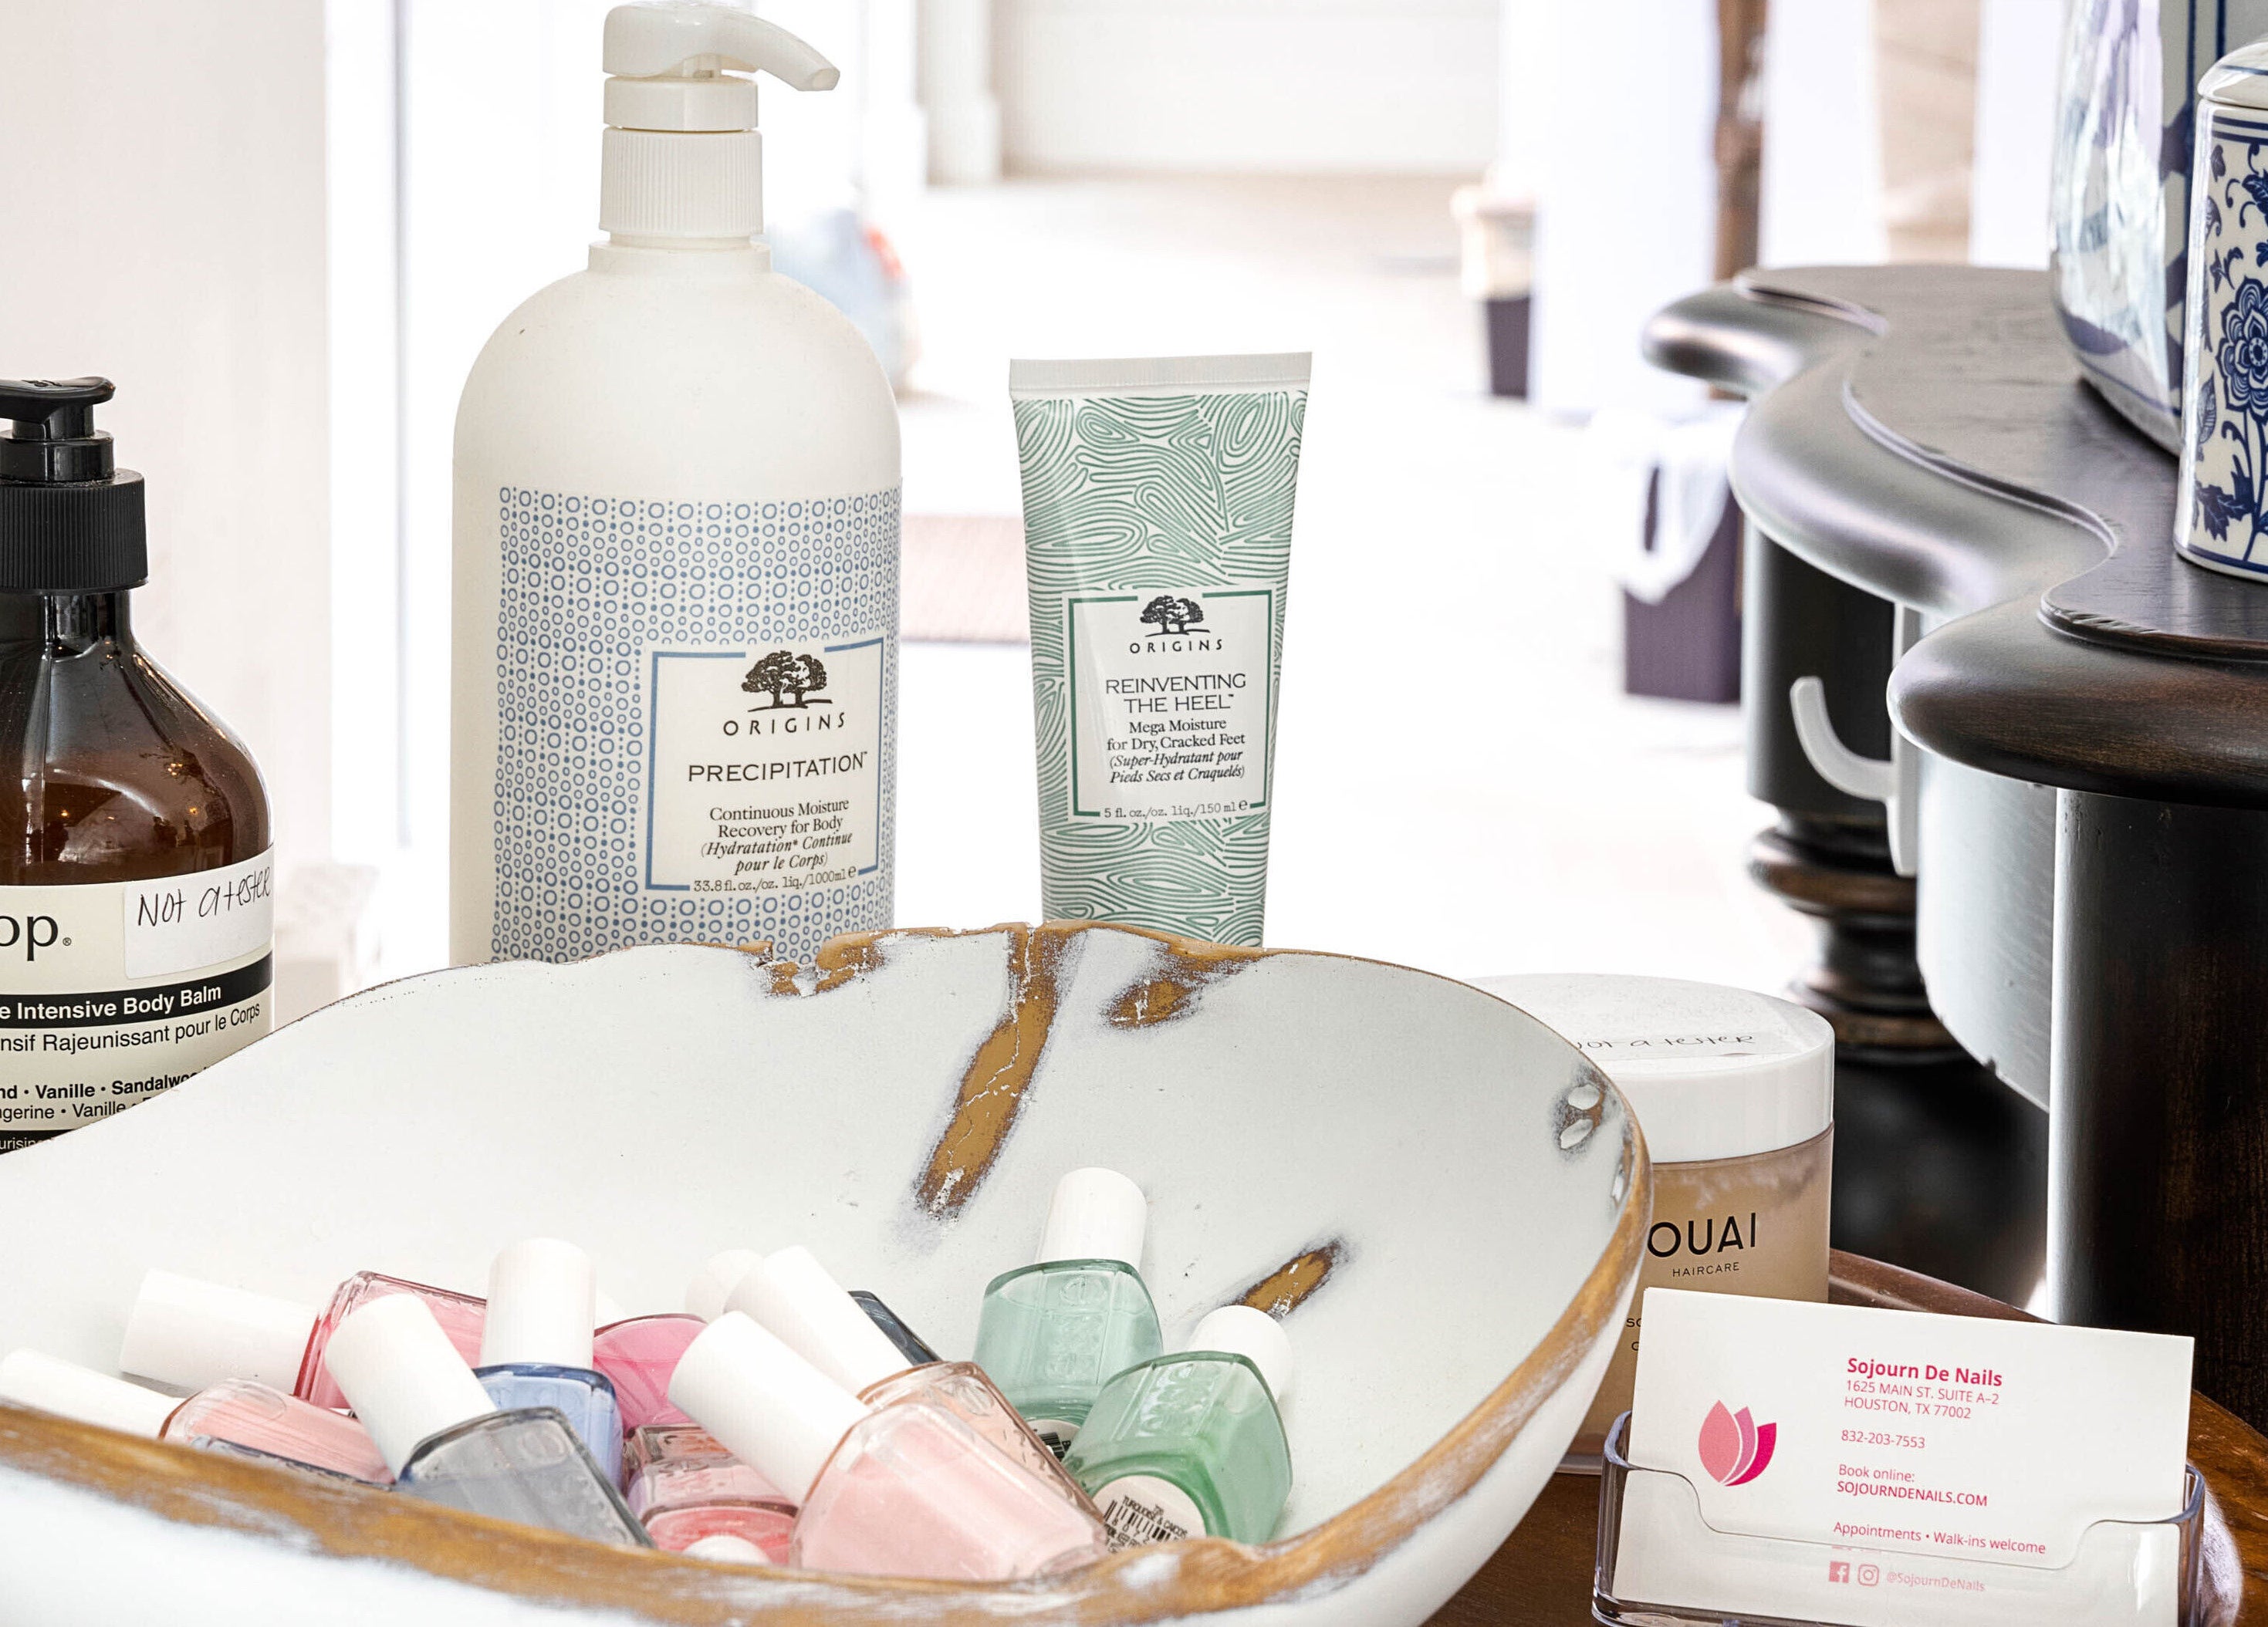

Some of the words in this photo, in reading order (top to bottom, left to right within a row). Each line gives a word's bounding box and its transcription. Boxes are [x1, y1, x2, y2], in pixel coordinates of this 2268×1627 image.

[1130, 639, 1222, 653] ORIGINS
[1106, 673, 1246, 694] REINVENTING
[1124, 697, 1168, 713] THE
[723, 713, 845, 735] ORIGINS
[1129, 722, 1165, 735] Mega
[1169, 718, 1227, 732] Moisture
[1107, 738, 1127, 751] for
[1160, 734, 1215, 748] Cracked
[1219, 734, 1246, 746] Feet
[1110, 752, 1214, 769] (Super-Hydratant
[1216, 751, 1243, 765] pour
[1110, 771, 1143, 783] Pieds
[1146, 769, 1171, 782] Secs
[1173, 770, 1184, 781] et
[710, 806, 794, 821] Continuous
[798, 800, 849, 815] Moisture
[1104, 808, 1111, 818] 5
[718, 825, 786, 839] Recovery
[792, 821, 810, 833] for
[813, 815, 843, 832] Body
[803, 831, 853, 849] Continue
[735, 859, 769, 876] pour
[773, 856, 784, 869] le
[789, 852, 828, 870] Corps)
[18, 1001, 117, 1019] Intensive
[123, 994, 174, 1014] Body
[181, 985, 221, 1007] Balm
[43, 1026, 169, 1055] Rajeunissant
[175, 1021, 211, 1044] pour
[215, 1015, 227, 1031] le
[230, 1003, 260, 1026] Corps
[35, 1083, 95, 1099] Vanille
[73, 1101, 126, 1117] Vanille
[1647, 1213, 1756, 1257] OUAI
[1672, 1262, 1740, 1278] HAIRCARE
[1847, 1358, 1919, 1379] Sojourn
[1925, 1365, 1949, 1382] De
[1955, 1368, 2003, 1386] Nails
[1847, 1380, 1875, 1393] 1625
[1879, 1383, 1912, 1397] MAIN
[1916, 1386, 1934, 1399] ST.
[1938, 1388, 1972, 1403] SUITE
[1844, 1396, 1911, 1414] HOUSTON,
[1915, 1403, 1930, 1415] TX
[1934, 1405, 1971, 1419] 77002
[1841, 1430, 1925, 1449] 832-203-7553
[1838, 1464, 1869, 1477] Book
[1873, 1469, 1915, 1482] online:
[1837, 1480, 1987, 1506] SOJOURNDENAILS.COM
[1834, 1521, 1922, 1541] Appointments
[1934, 1531, 1986, 1548] Walk-ins
[1990, 1539, 2046, 1554] welcome
[1887, 1572, 1986, 1592] @SojournDeNails
